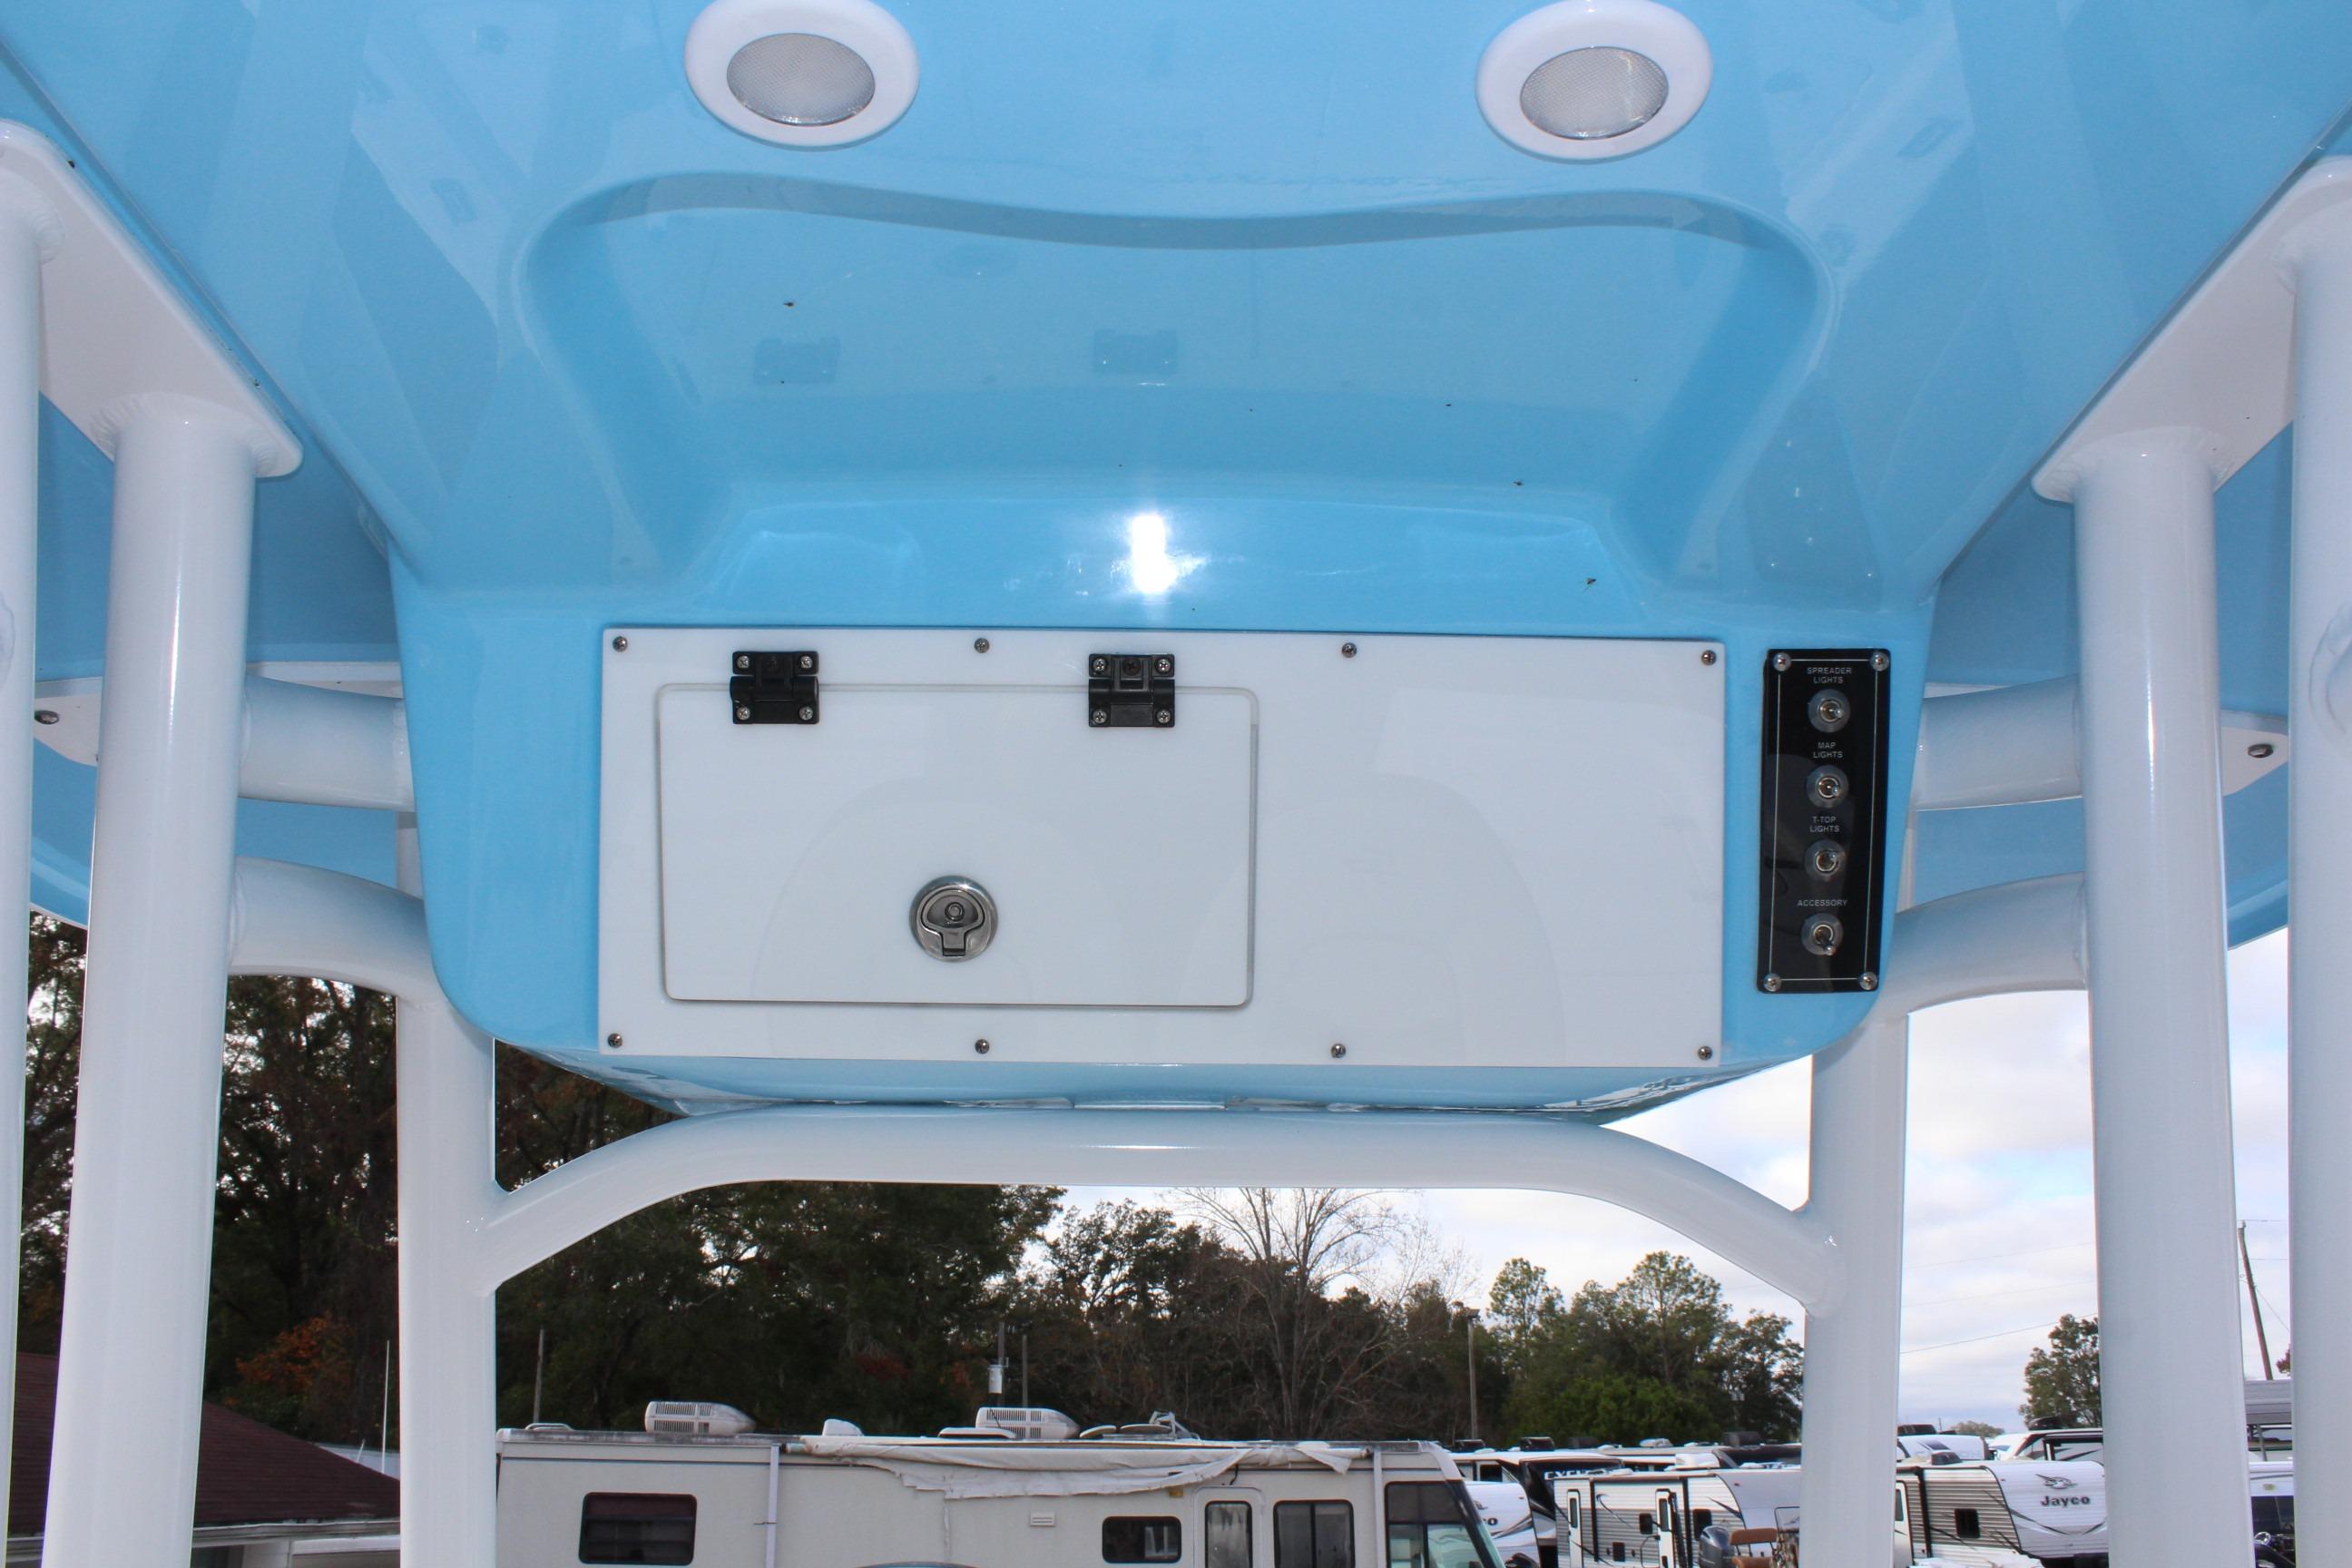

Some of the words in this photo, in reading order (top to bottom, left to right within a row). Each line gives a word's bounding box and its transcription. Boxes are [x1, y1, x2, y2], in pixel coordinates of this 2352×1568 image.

[1813, 676, 1844, 684] LIGHTS
[1809, 825, 1840, 833] LIGHTS
[2041, 1495, 2091, 1508] Jayco
